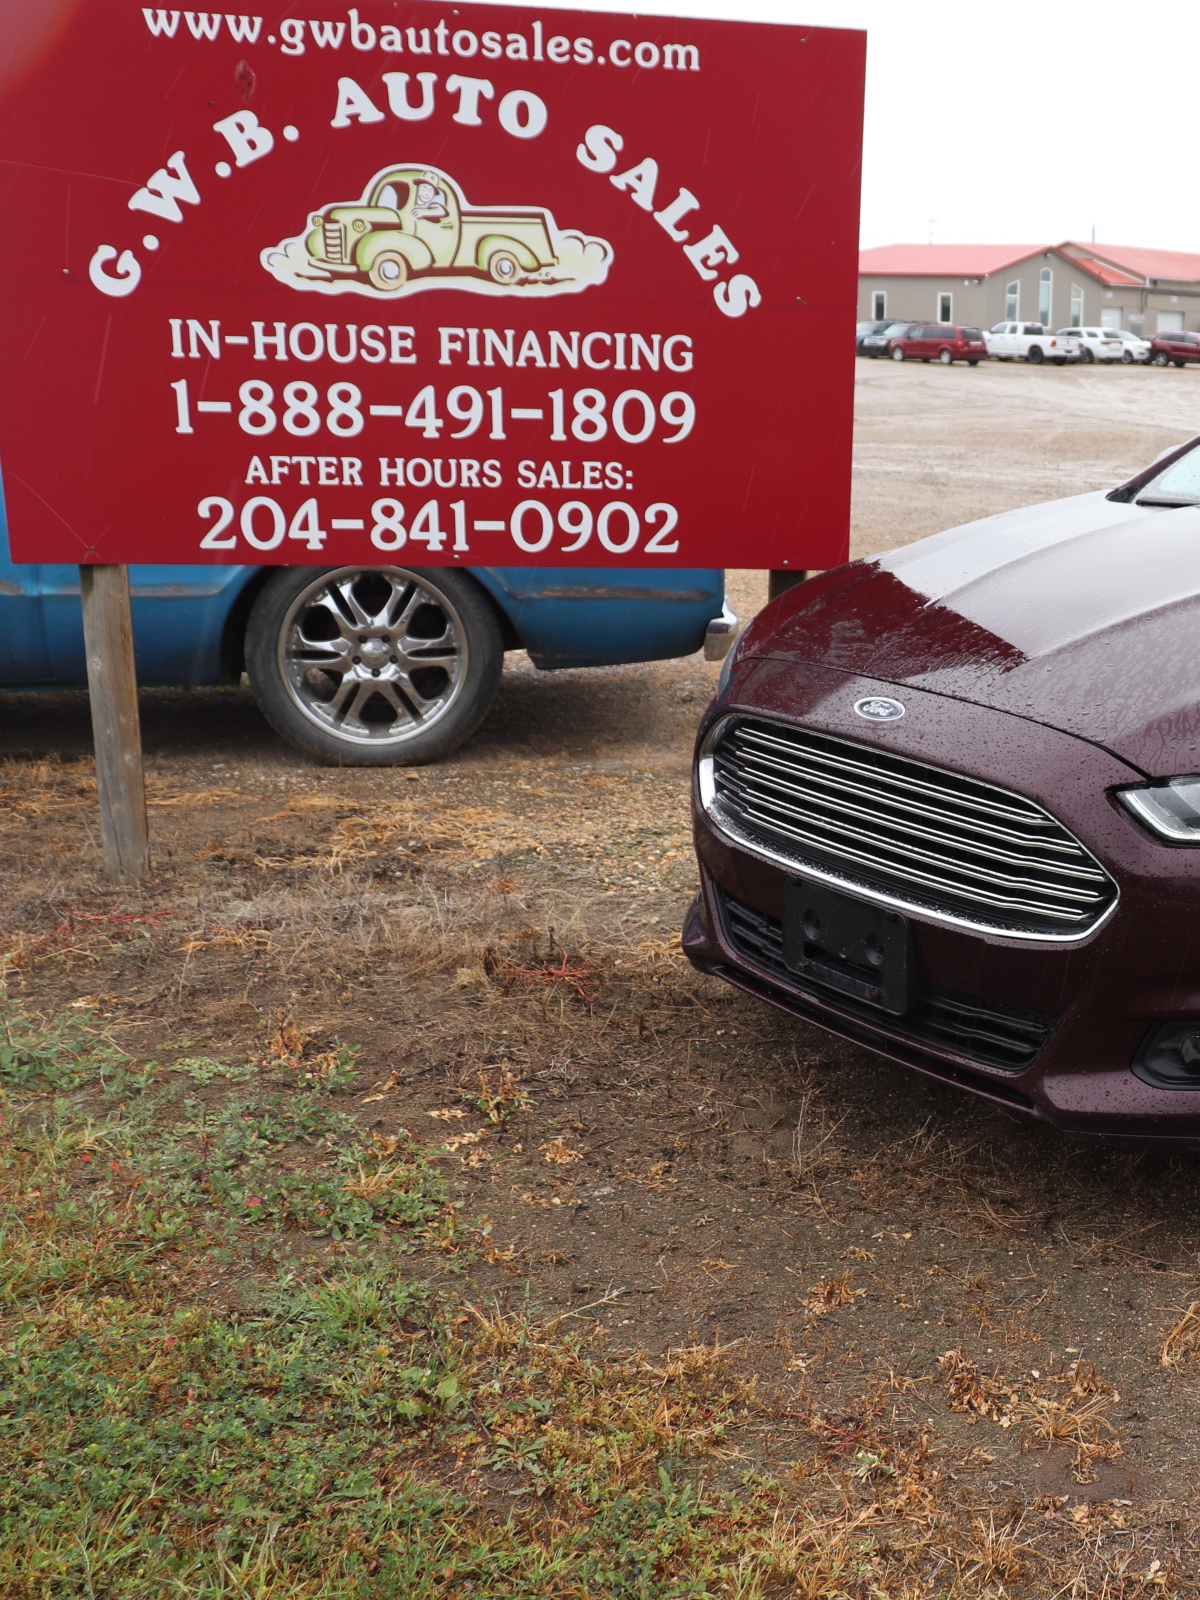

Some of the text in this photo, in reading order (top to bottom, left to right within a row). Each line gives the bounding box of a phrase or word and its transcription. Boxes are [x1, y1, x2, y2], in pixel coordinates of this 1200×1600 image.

[141, 7, 701, 71] www.gwbautosales.com
[330, 71, 548, 139] AUTO
[575, 124, 764, 318] SALES
[168, 318, 694, 373] IN-HOUSE FINANCING
[170, 378, 697, 444] 1-888-491-1809
[244, 455, 633, 490] AFTER HOURS SALES:
[196, 495, 680, 554] 204-841-0902
